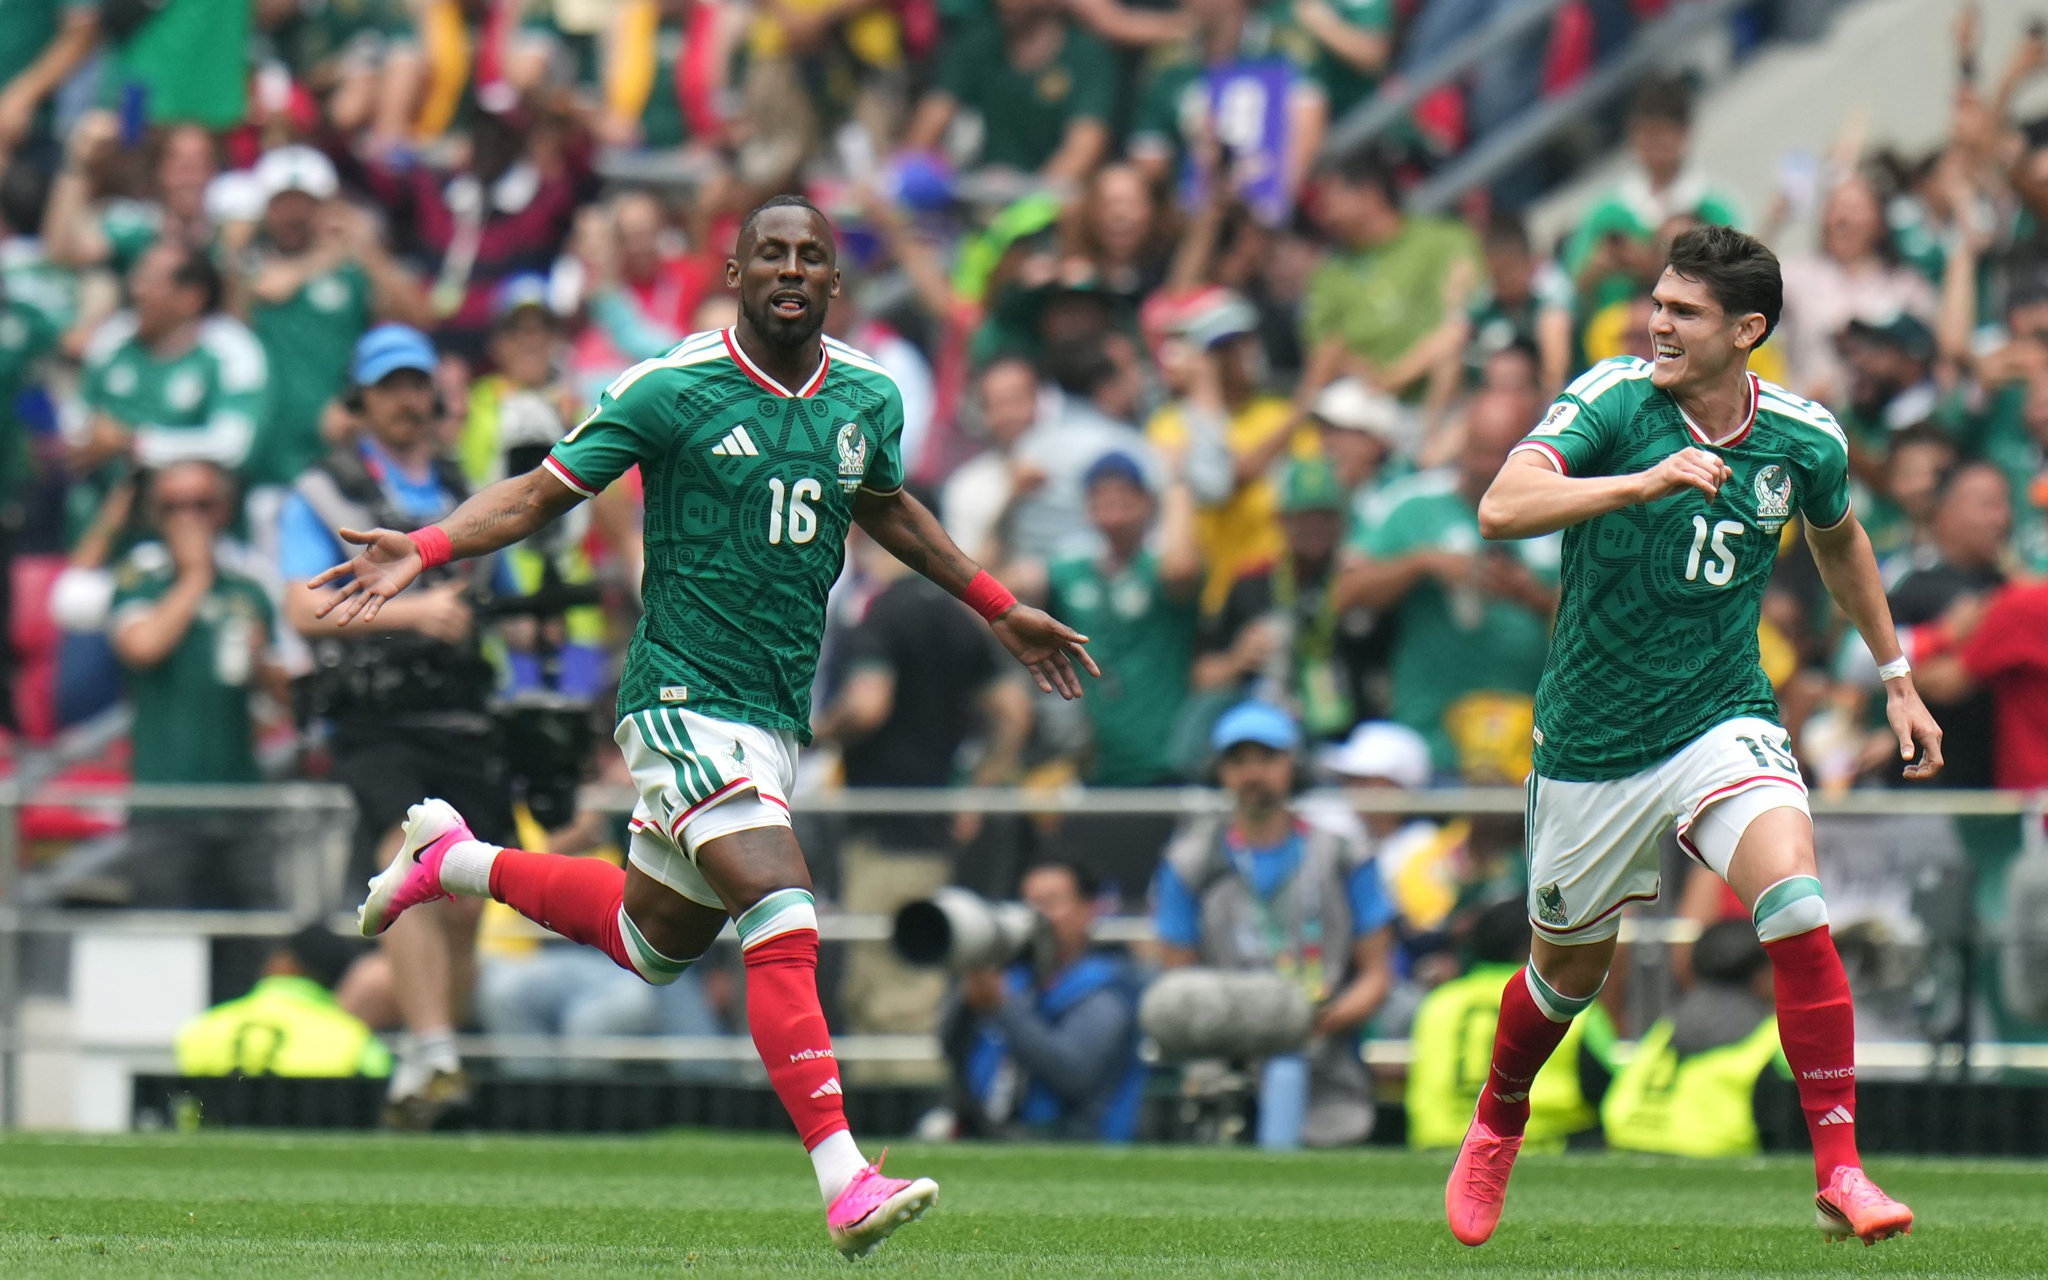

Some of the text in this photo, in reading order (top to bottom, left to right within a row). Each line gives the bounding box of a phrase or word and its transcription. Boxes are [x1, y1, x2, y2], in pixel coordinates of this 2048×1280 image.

[768, 477, 822, 545] 16
[1685, 514, 1745, 586] 15
[1735, 733, 1799, 776] 15
